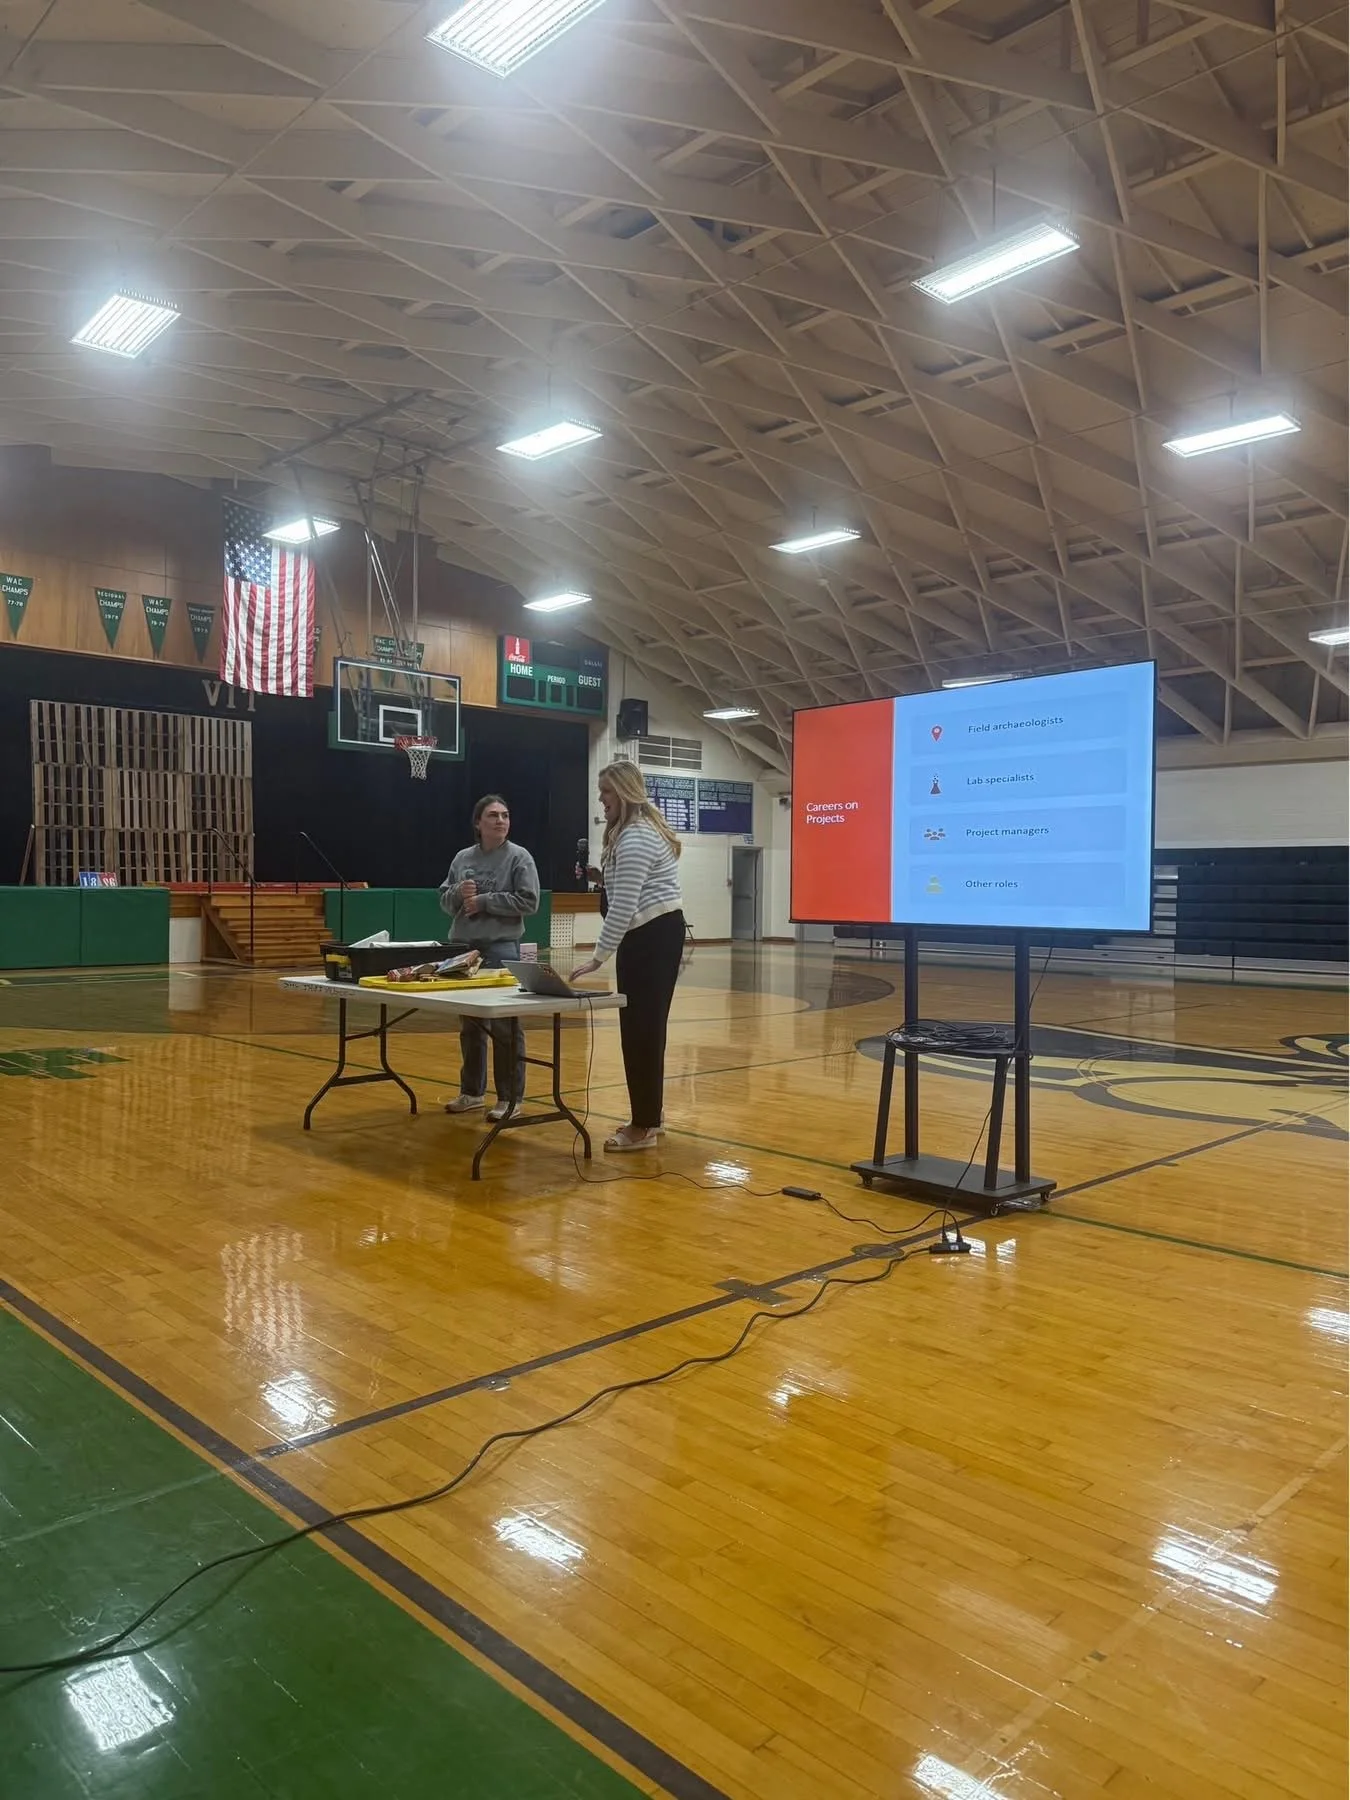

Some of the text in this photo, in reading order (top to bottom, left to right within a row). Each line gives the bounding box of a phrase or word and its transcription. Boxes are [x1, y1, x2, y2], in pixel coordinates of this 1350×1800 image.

[6, 576, 23, 586] WAC
[1, 584, 29, 596] CHAMPS
[99, 599, 124, 609] CHAMPS
[145, 606, 169, 616] CHAMPS
[510, 663, 533, 676] HOME
[547, 674, 566, 685] PERIOD
[578, 674, 602, 687] GUEST
[968, 716, 1064, 733] Field archaeologists
[967, 773, 1035, 785] Lab specialists
[806, 801, 859, 812] Careers on
[806, 814, 846, 825] Projects
[966, 827, 1050, 838] Project managers
[965, 879, 1019, 888] Other roles
